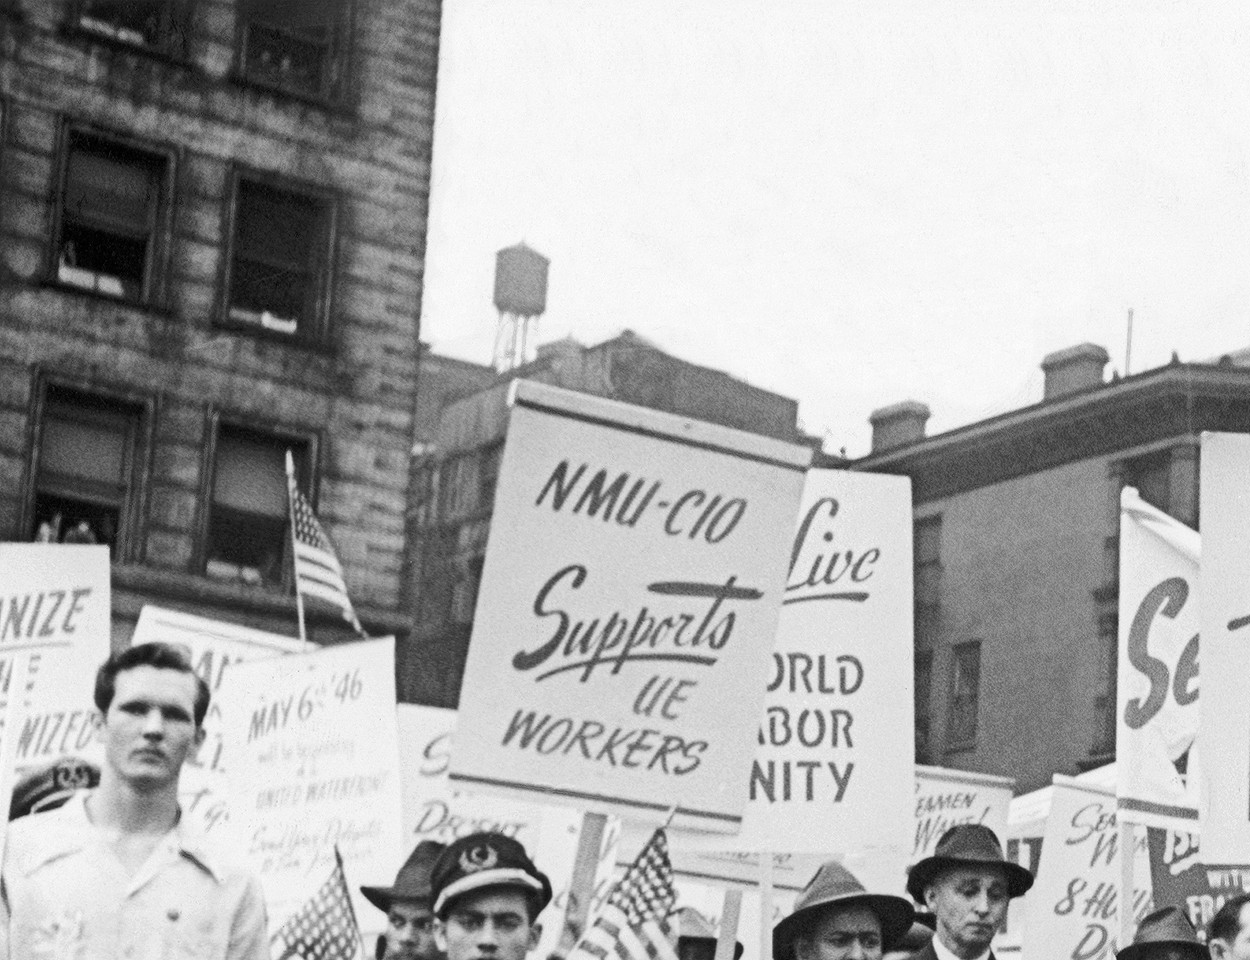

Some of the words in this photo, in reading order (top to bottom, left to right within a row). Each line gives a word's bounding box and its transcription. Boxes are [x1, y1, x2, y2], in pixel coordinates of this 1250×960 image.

[536, 460, 747, 544] NMU-CIO
[786, 497, 881, 592] Live
[0, 586, 93, 641] NIZE
[512, 565, 765, 682] Supports
[633, 675, 698, 721] UE
[767, 652, 864, 695] ORLD
[247, 694, 294, 744] MAY
[501, 709, 709, 776] WORKERS
[758, 706, 854, 748] BOR
[750, 759, 855, 803] NITY
[914, 791, 977, 818] EAMEN
